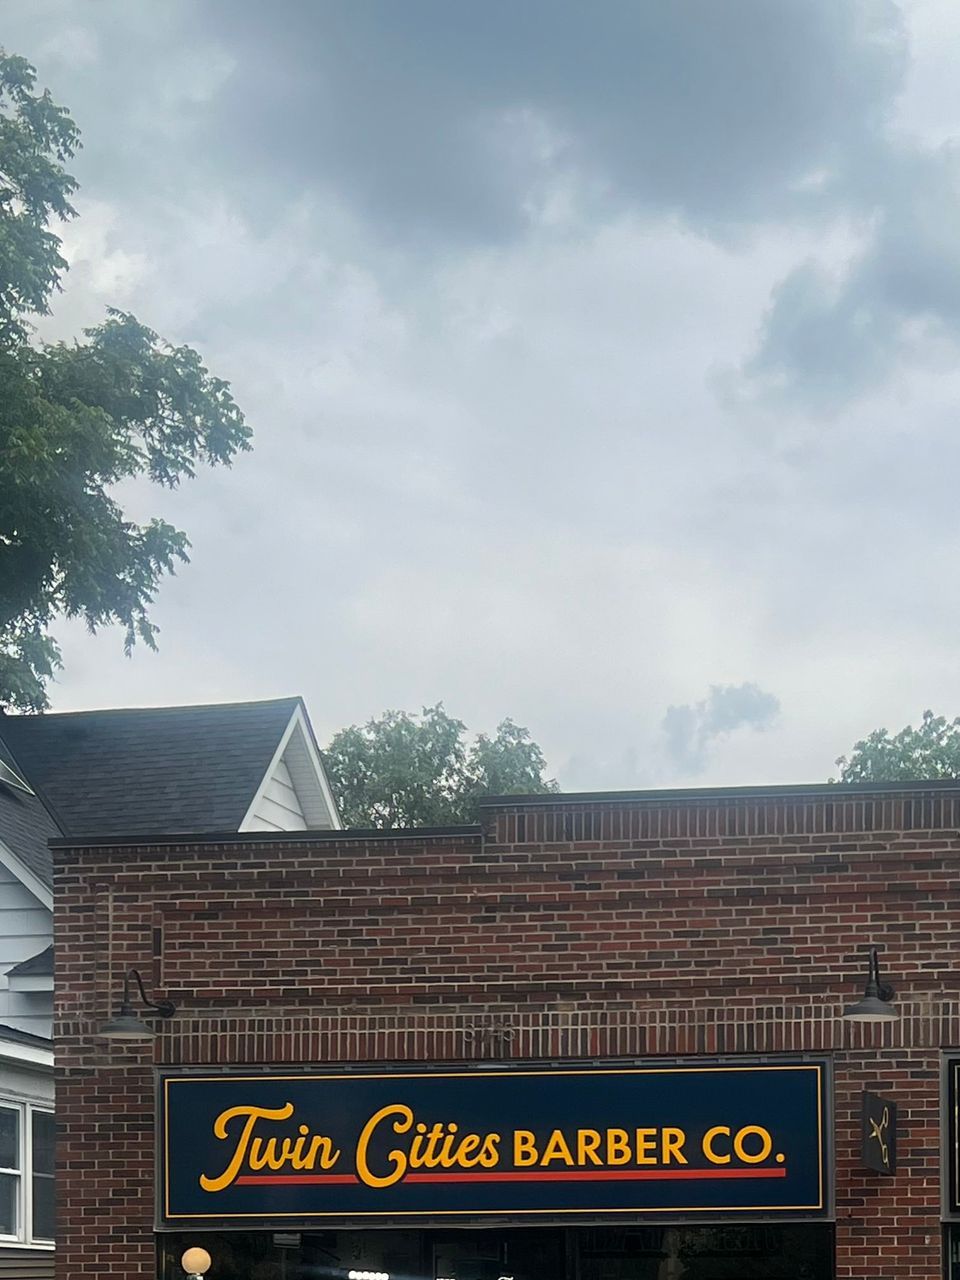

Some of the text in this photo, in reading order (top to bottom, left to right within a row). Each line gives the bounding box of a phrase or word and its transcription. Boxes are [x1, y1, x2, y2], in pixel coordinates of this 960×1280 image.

[200, 1102, 786, 1192] Twin Cities BARBER CO.
